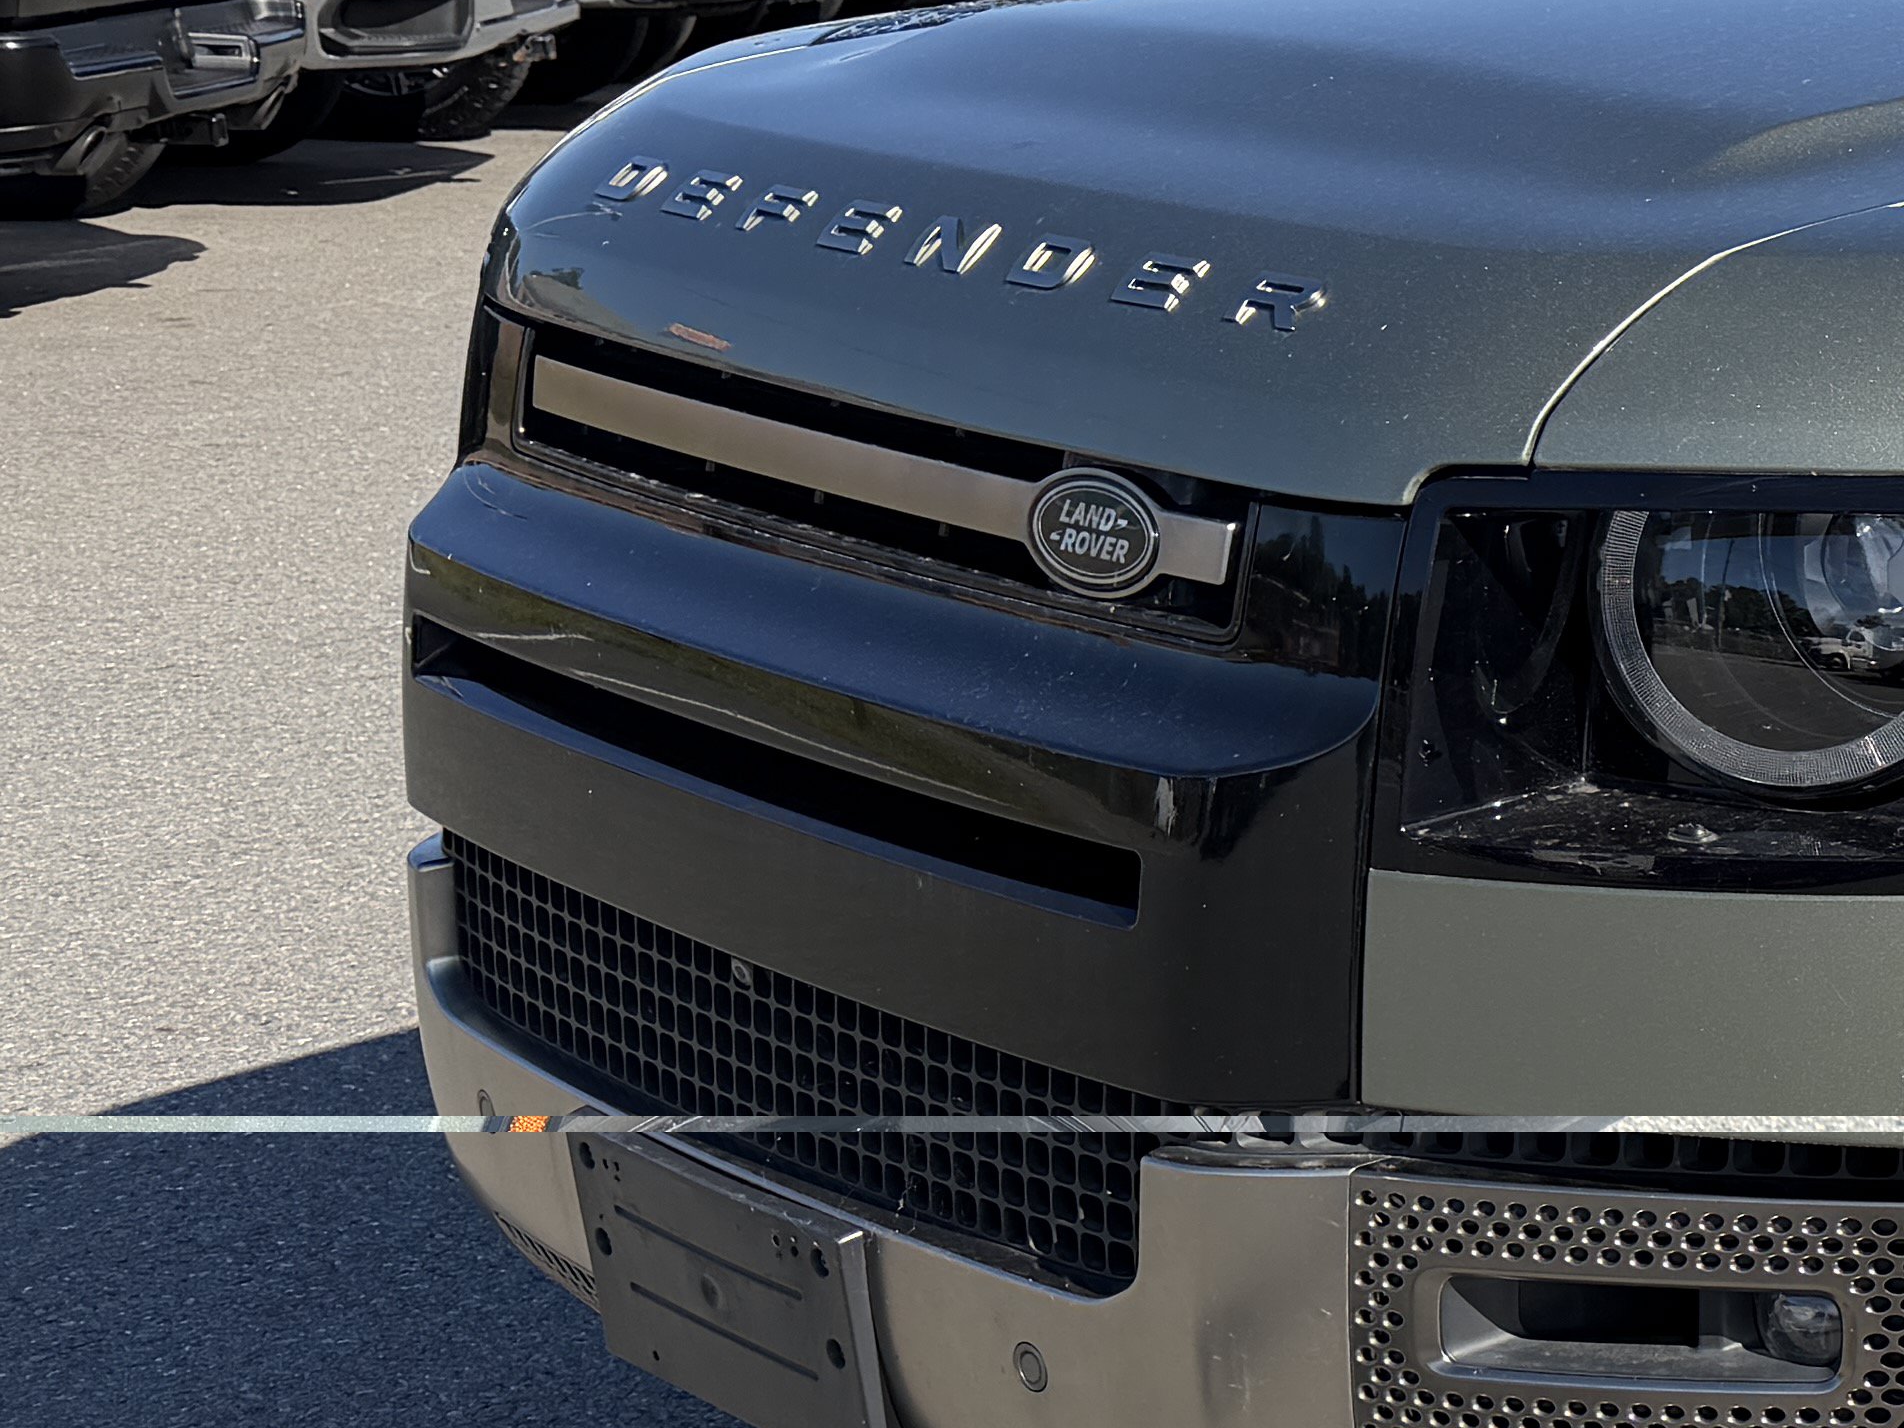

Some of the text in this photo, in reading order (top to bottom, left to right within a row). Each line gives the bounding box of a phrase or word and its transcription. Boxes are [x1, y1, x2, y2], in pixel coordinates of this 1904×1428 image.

[594, 155, 1328, 332] DEFENDER
[1059, 498, 1117, 532] LAND
[1060, 527, 1129, 564] ROVER
